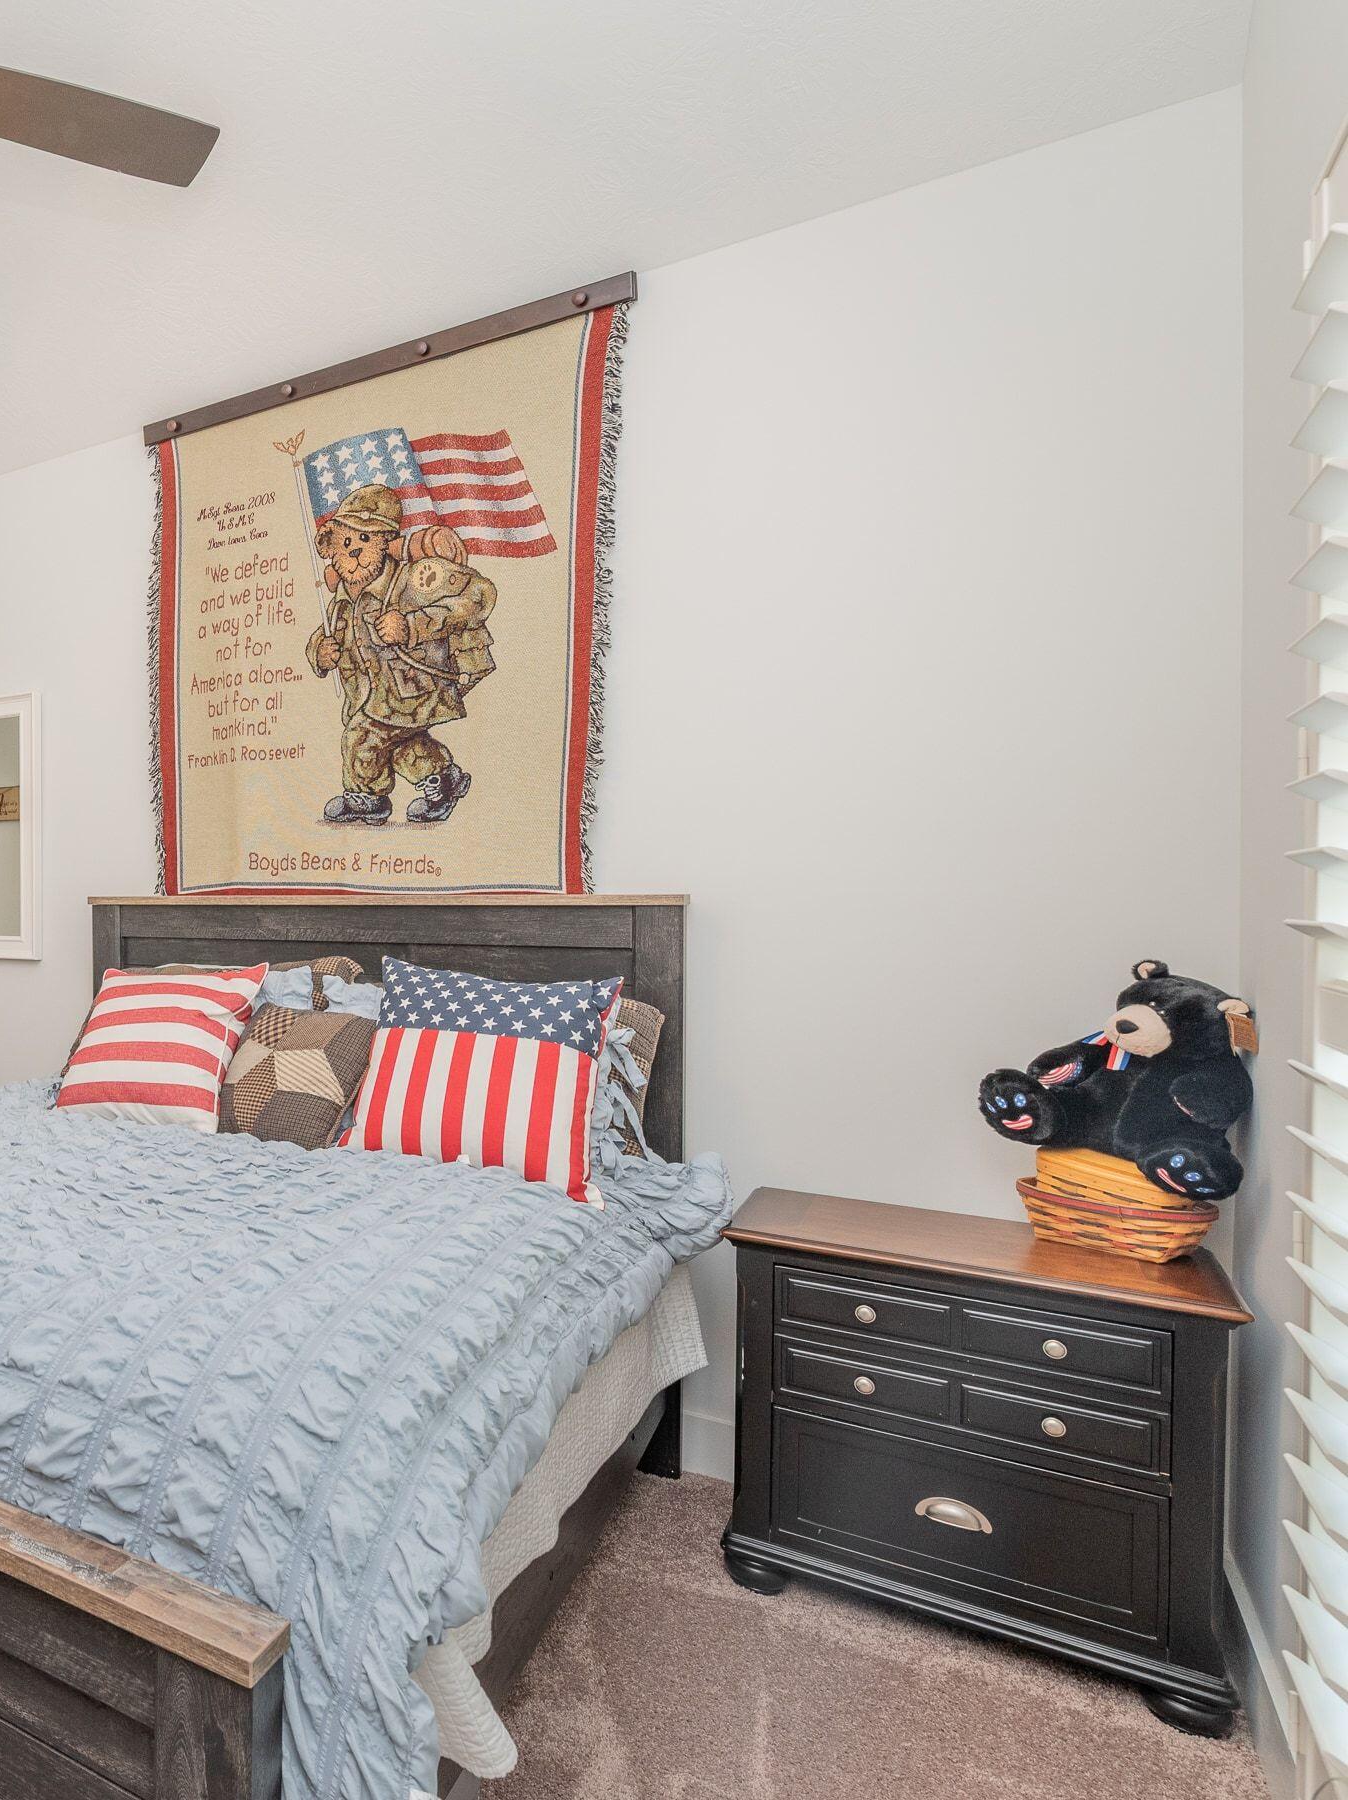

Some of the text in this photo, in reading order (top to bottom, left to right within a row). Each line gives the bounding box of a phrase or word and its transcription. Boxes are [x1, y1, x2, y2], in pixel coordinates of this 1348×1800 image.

[248, 491, 276, 509] 2008
[206, 552, 289, 583] "We defend
[200, 577, 294, 613] and we build
[198, 600, 296, 639] a way of life,
[216, 636, 272, 662] not for
[191, 664, 302, 695] America alone...
[208, 690, 283, 718] but for all
[212, 716, 277, 740] mankind."
[187, 750, 228, 768] Franklin
[241, 743, 306, 761] Roosevelt
[248, 852, 297, 876] Boyds
[301, 851, 346, 871] Bears
[351, 852, 362, 871] &
